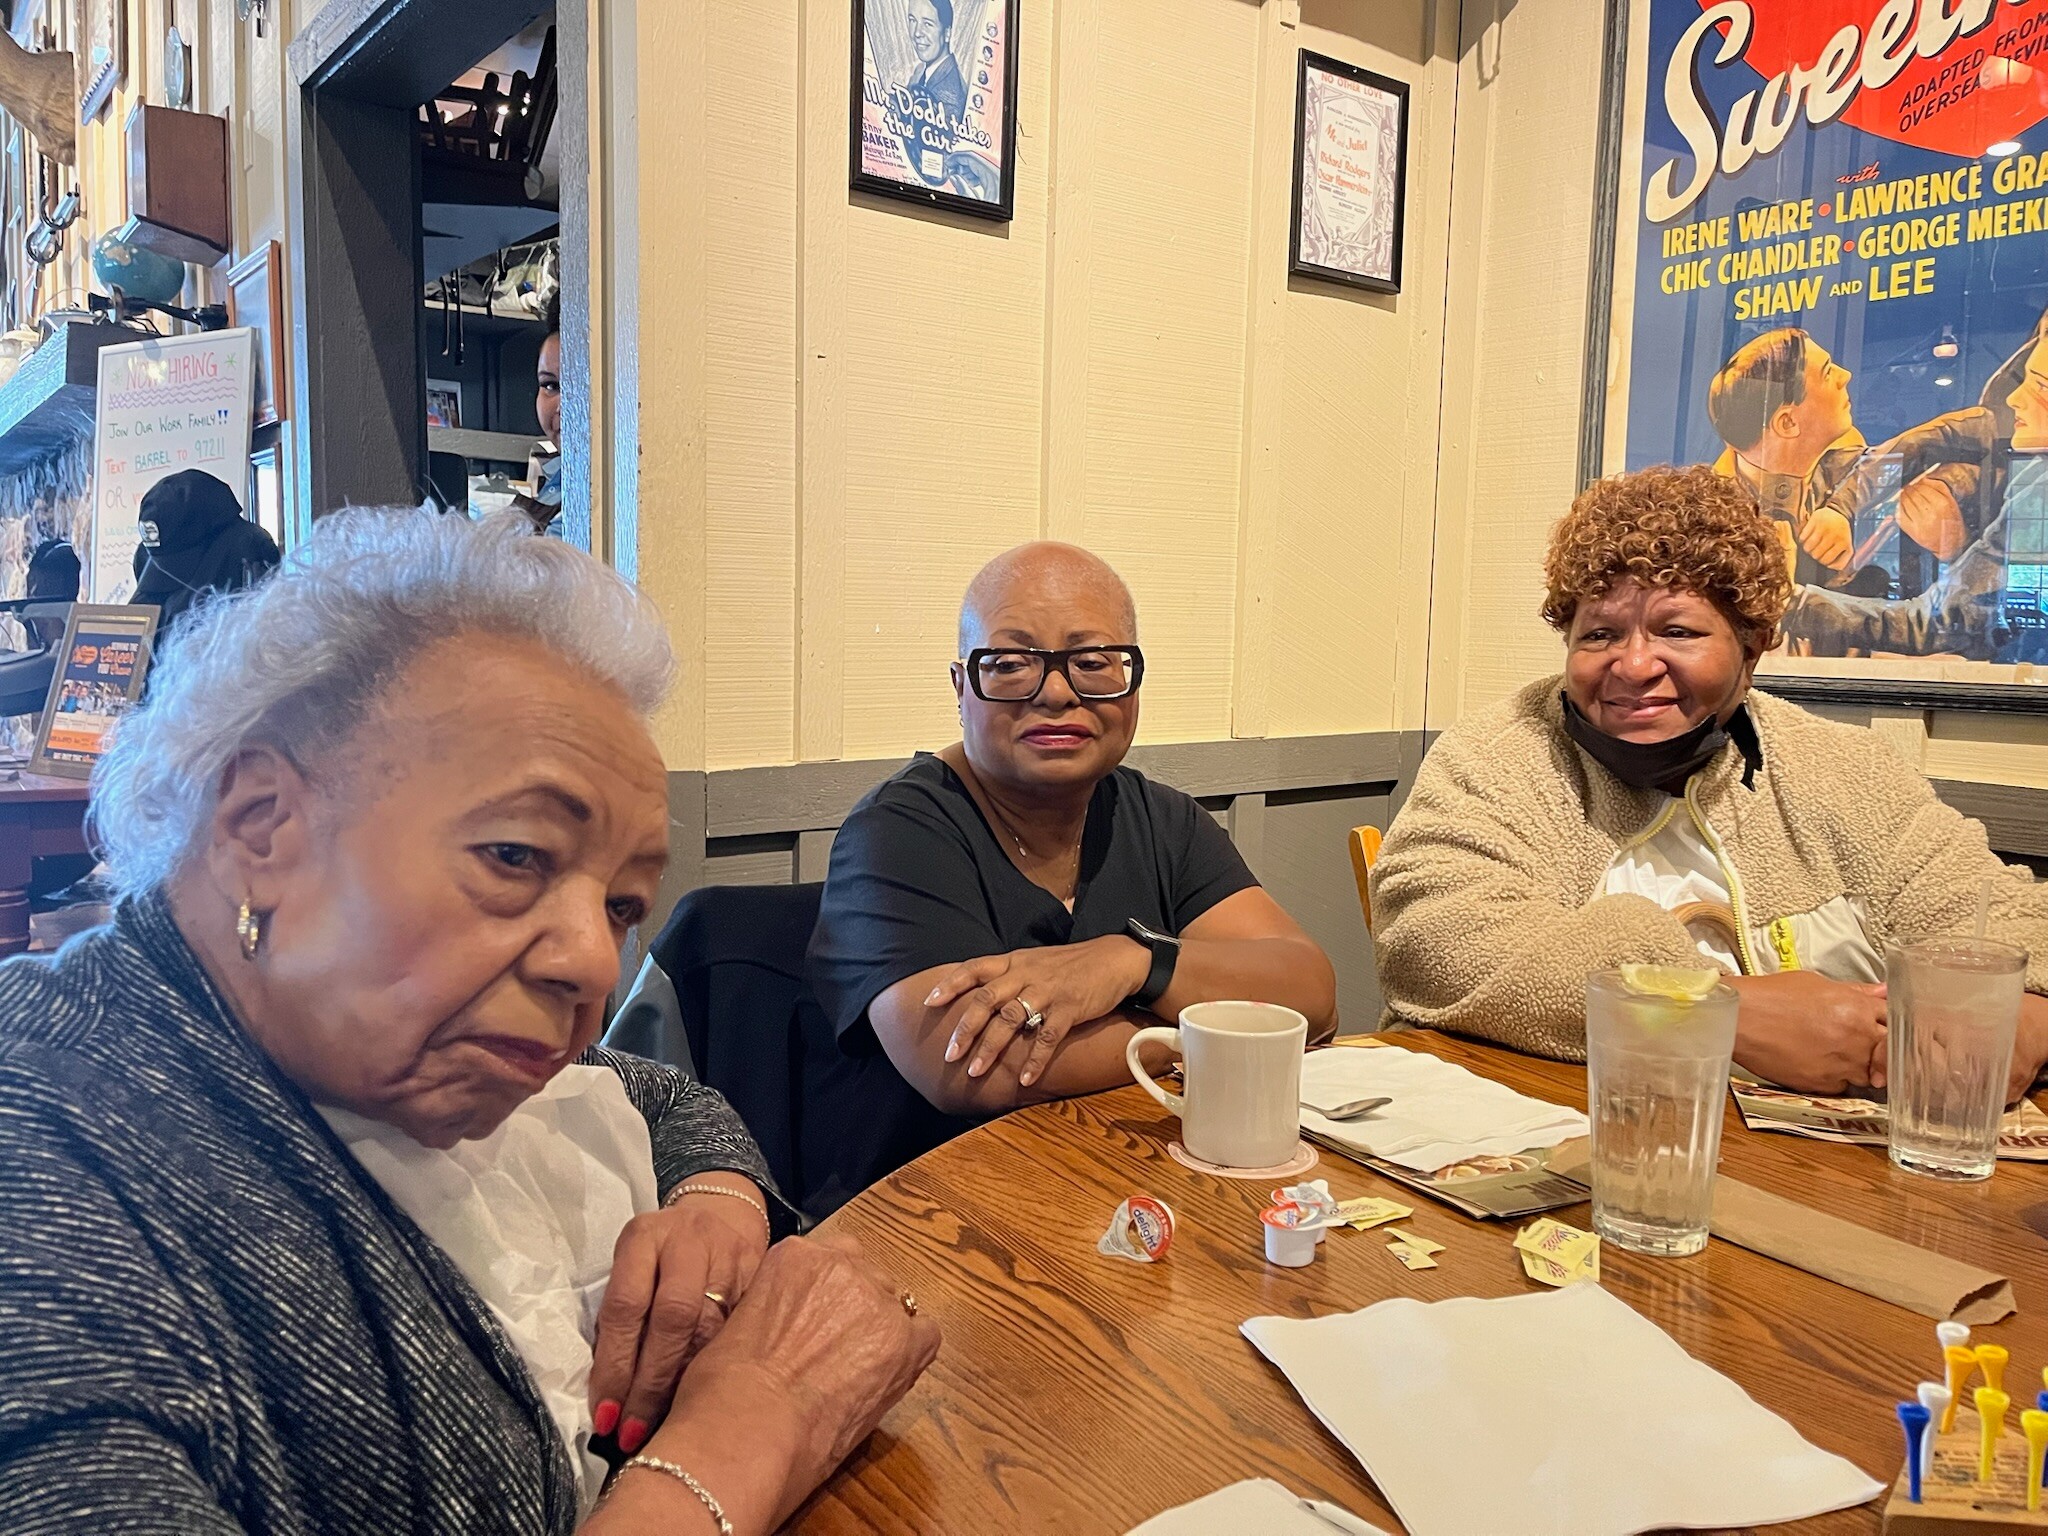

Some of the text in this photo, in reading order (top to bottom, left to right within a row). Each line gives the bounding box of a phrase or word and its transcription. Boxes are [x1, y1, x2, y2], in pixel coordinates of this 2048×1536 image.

[1320, 73, 1383, 100] NO OTHER LOVE
[1899, 48, 1985, 113] ADAPTED
[862, 79, 992, 149] Mr. Dodd takes
[1899, 67, 1991, 132] OVERSEAS
[862, 131, 899, 151] BAKER
[884, 112, 915, 139] the
[1345, 161, 1370, 179] Rodgers
[1836, 161, 1880, 183] with
[1662, 216, 1730, 258] IRENE
[1738, 198, 1814, 243] WARE
[1835, 164, 1982, 224] LAWRENCE
[1660, 257, 1712, 295] CHIC
[1717, 234, 1841, 285] CHANDLER
[1857, 212, 1960, 259] GEORGE
[1734, 257, 1935, 321] SHAW AND LEE
[168, 352, 218, 384] HIRING
[134, 451, 171, 470] BARREL
[105, 486, 127, 509] OR
[1133, 1209, 1158, 1249] delight
